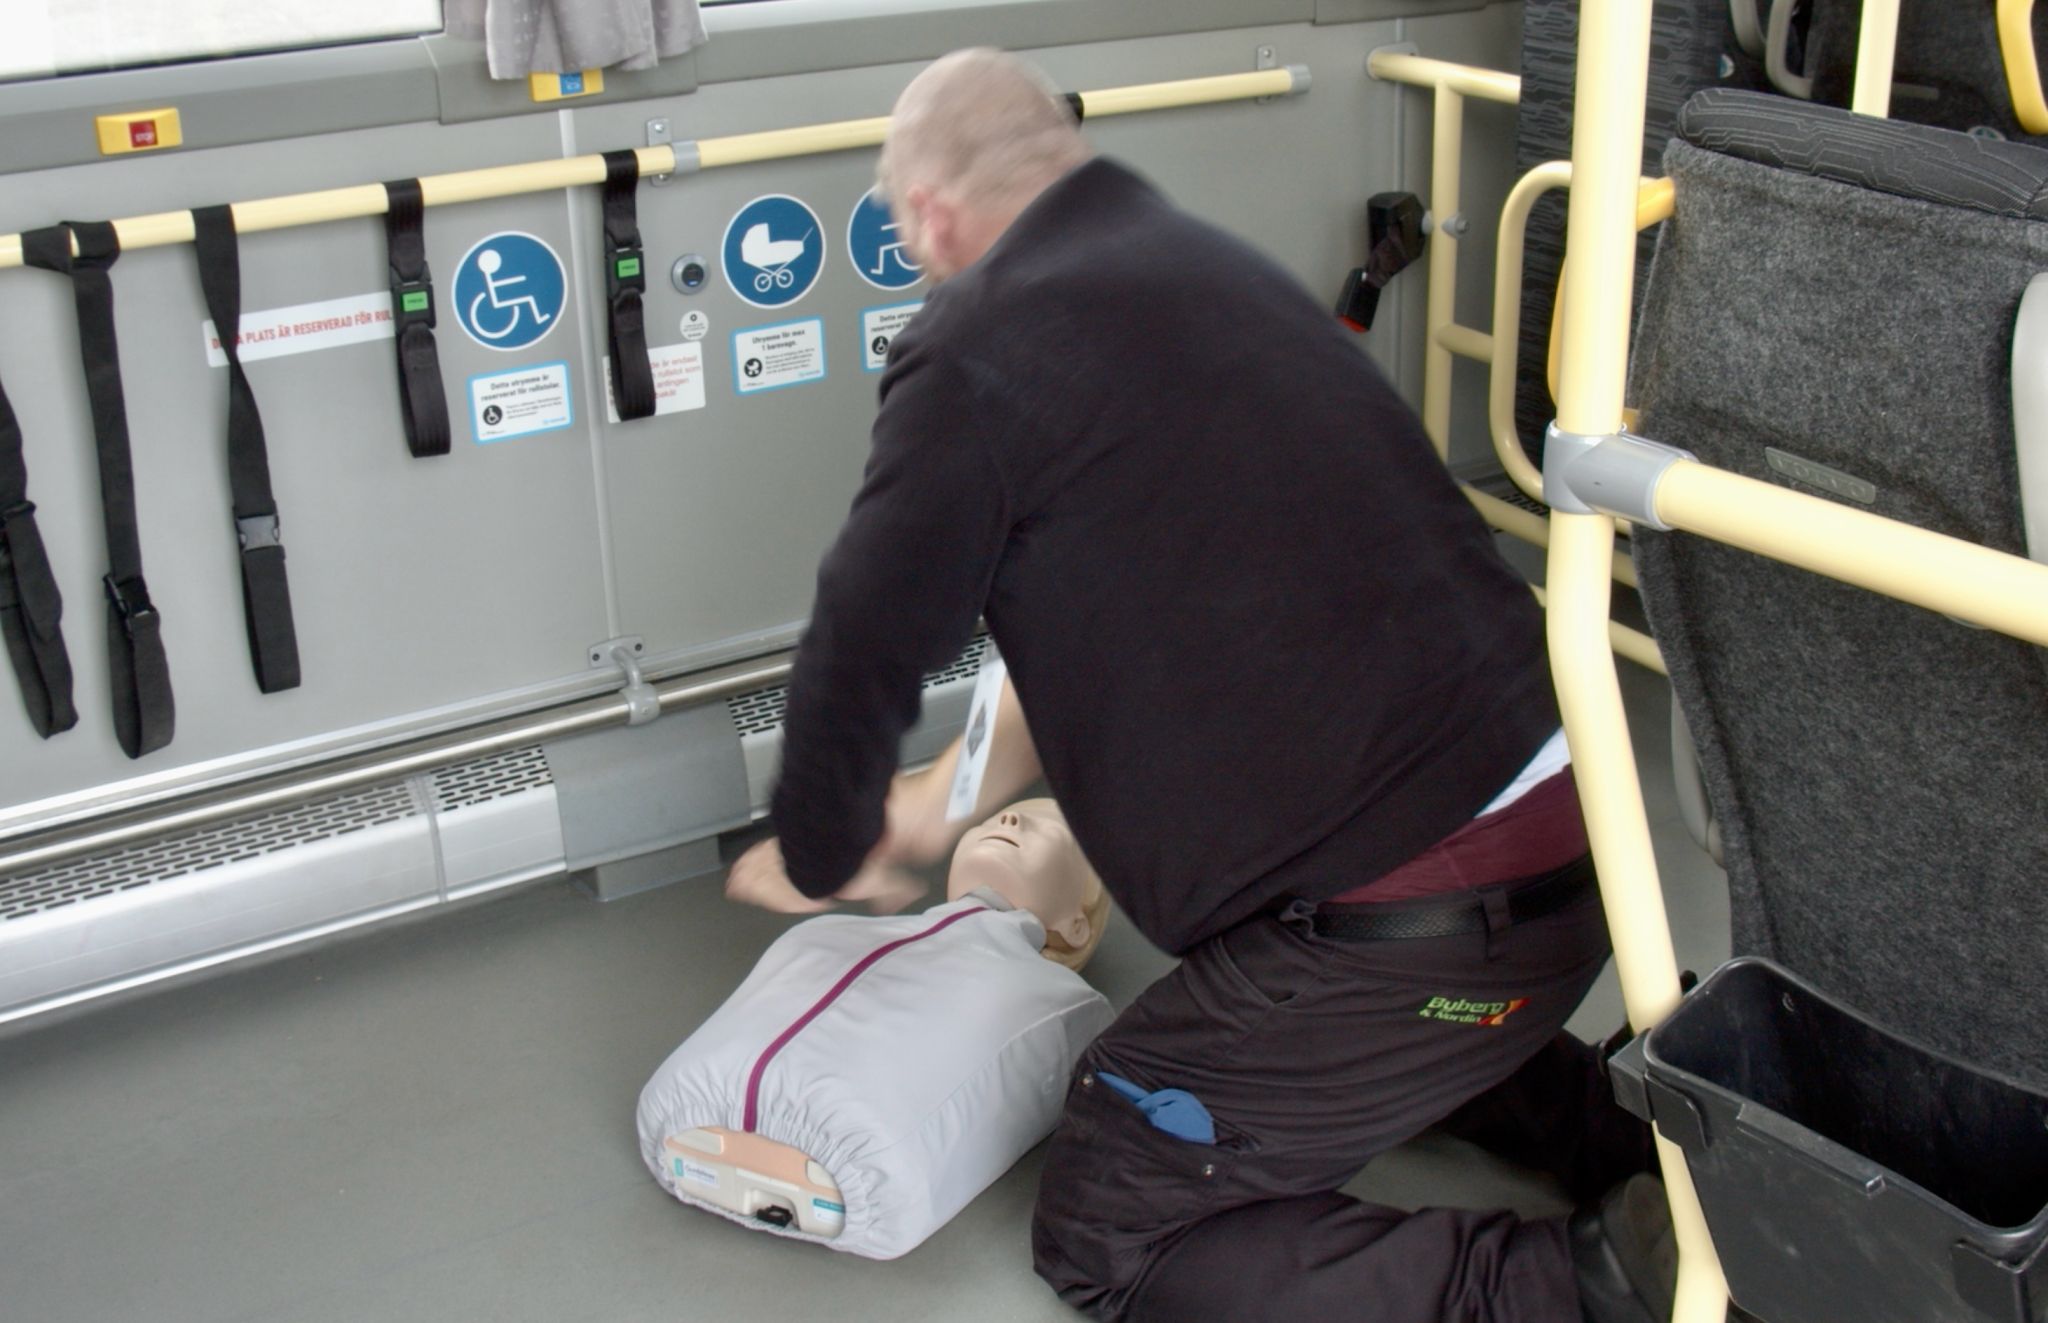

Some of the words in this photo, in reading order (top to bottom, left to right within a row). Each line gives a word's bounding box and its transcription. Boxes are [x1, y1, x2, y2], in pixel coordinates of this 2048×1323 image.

[246, 328, 276, 343] PLATS
[278, 324, 291, 338] ÄR
[293, 316, 353, 336] RESERVERAD
[355, 311, 372, 326] FÖR
[1427, 996, 1506, 1015] Byberg
